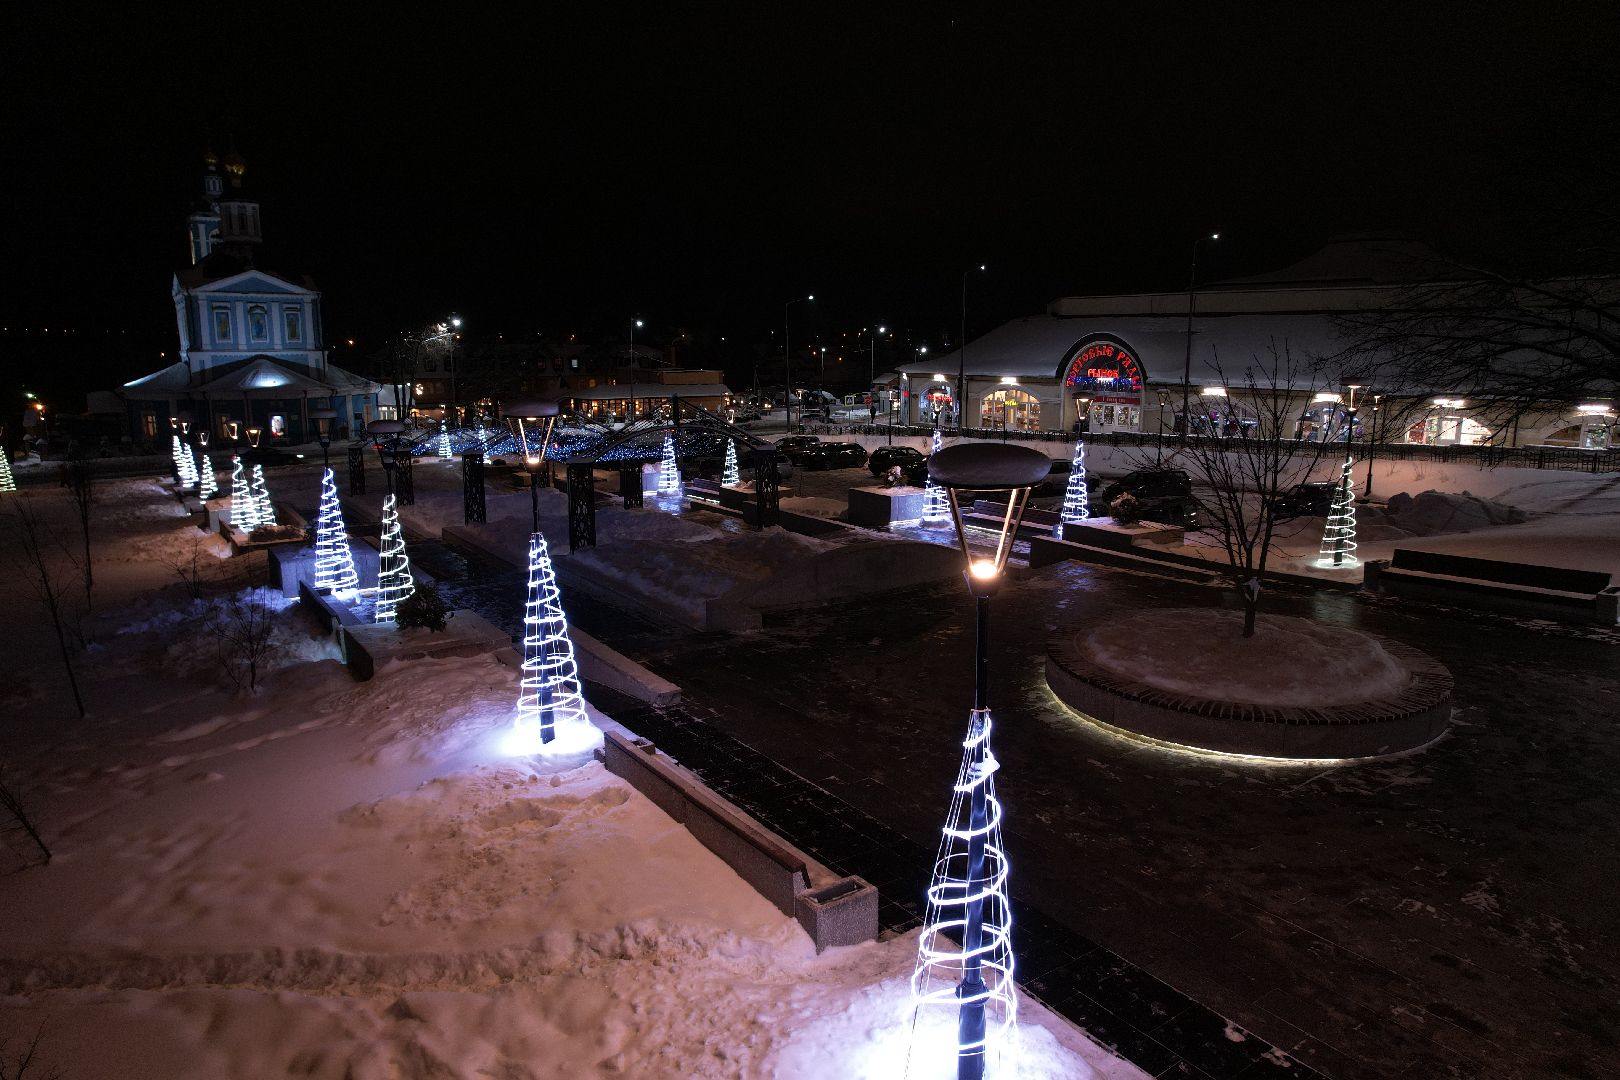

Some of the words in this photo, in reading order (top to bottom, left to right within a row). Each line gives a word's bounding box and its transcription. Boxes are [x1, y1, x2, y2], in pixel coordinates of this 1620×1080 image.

[1066, 345, 1114, 387] ТОРГОВЫЕ
[1117, 351, 1141, 389] РЯДЫ
[1087, 368, 1119, 378] РЫНОК
